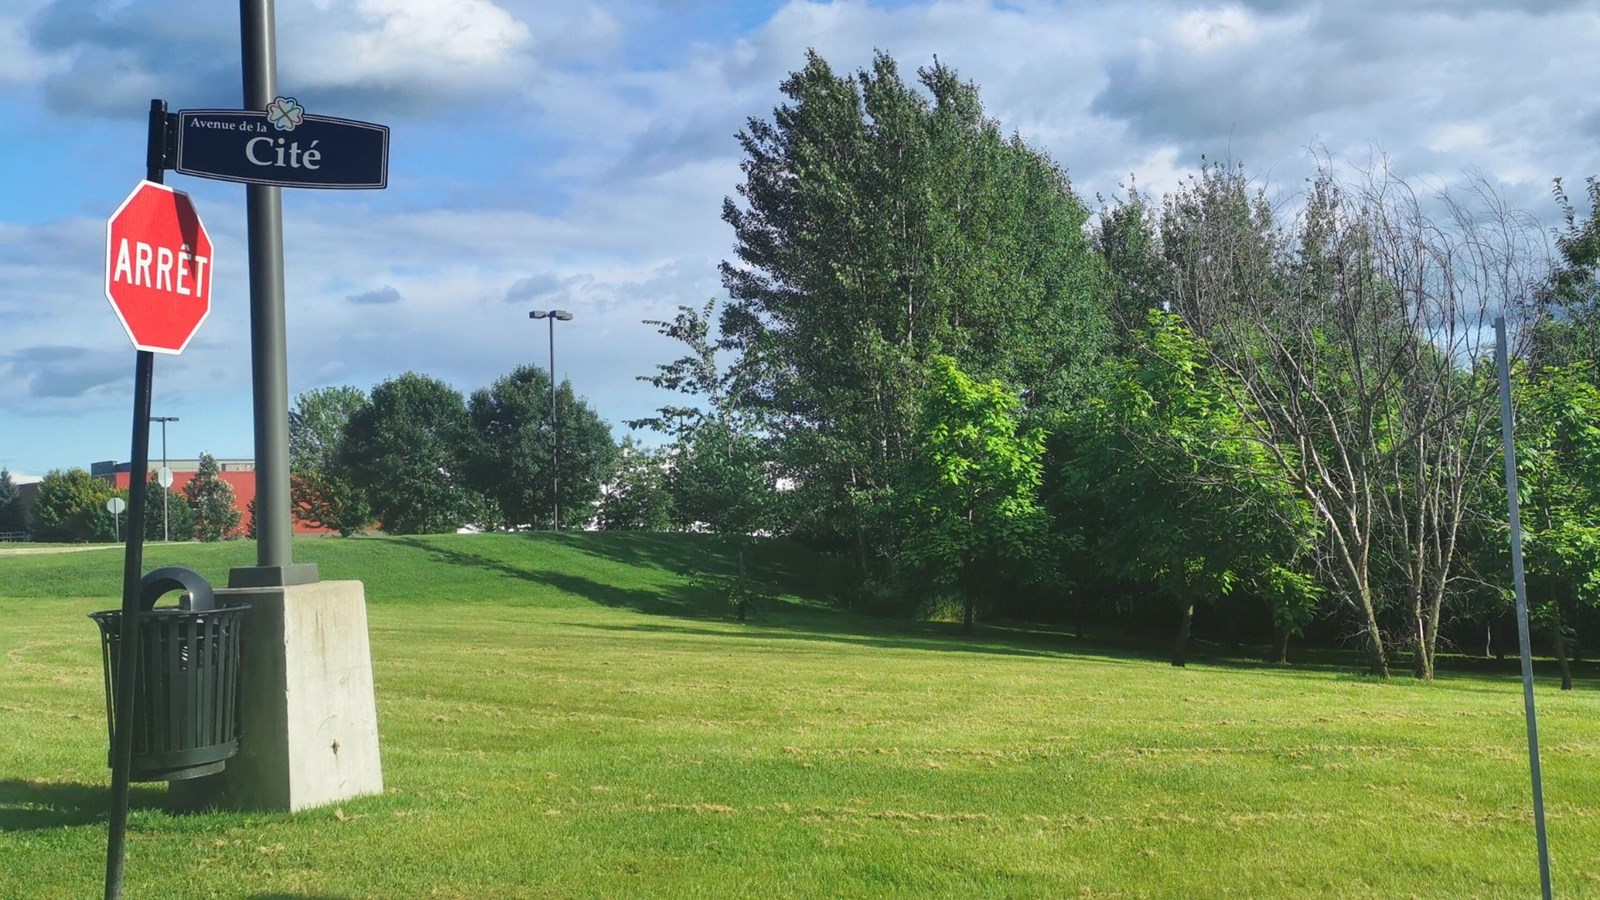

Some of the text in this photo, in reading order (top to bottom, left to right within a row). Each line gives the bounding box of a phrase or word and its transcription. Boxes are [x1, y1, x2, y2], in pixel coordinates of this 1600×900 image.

[190, 117, 268, 133] Avenue de la
[245, 136, 322, 170] Cité
[113, 237, 208, 298] ARRÊT
